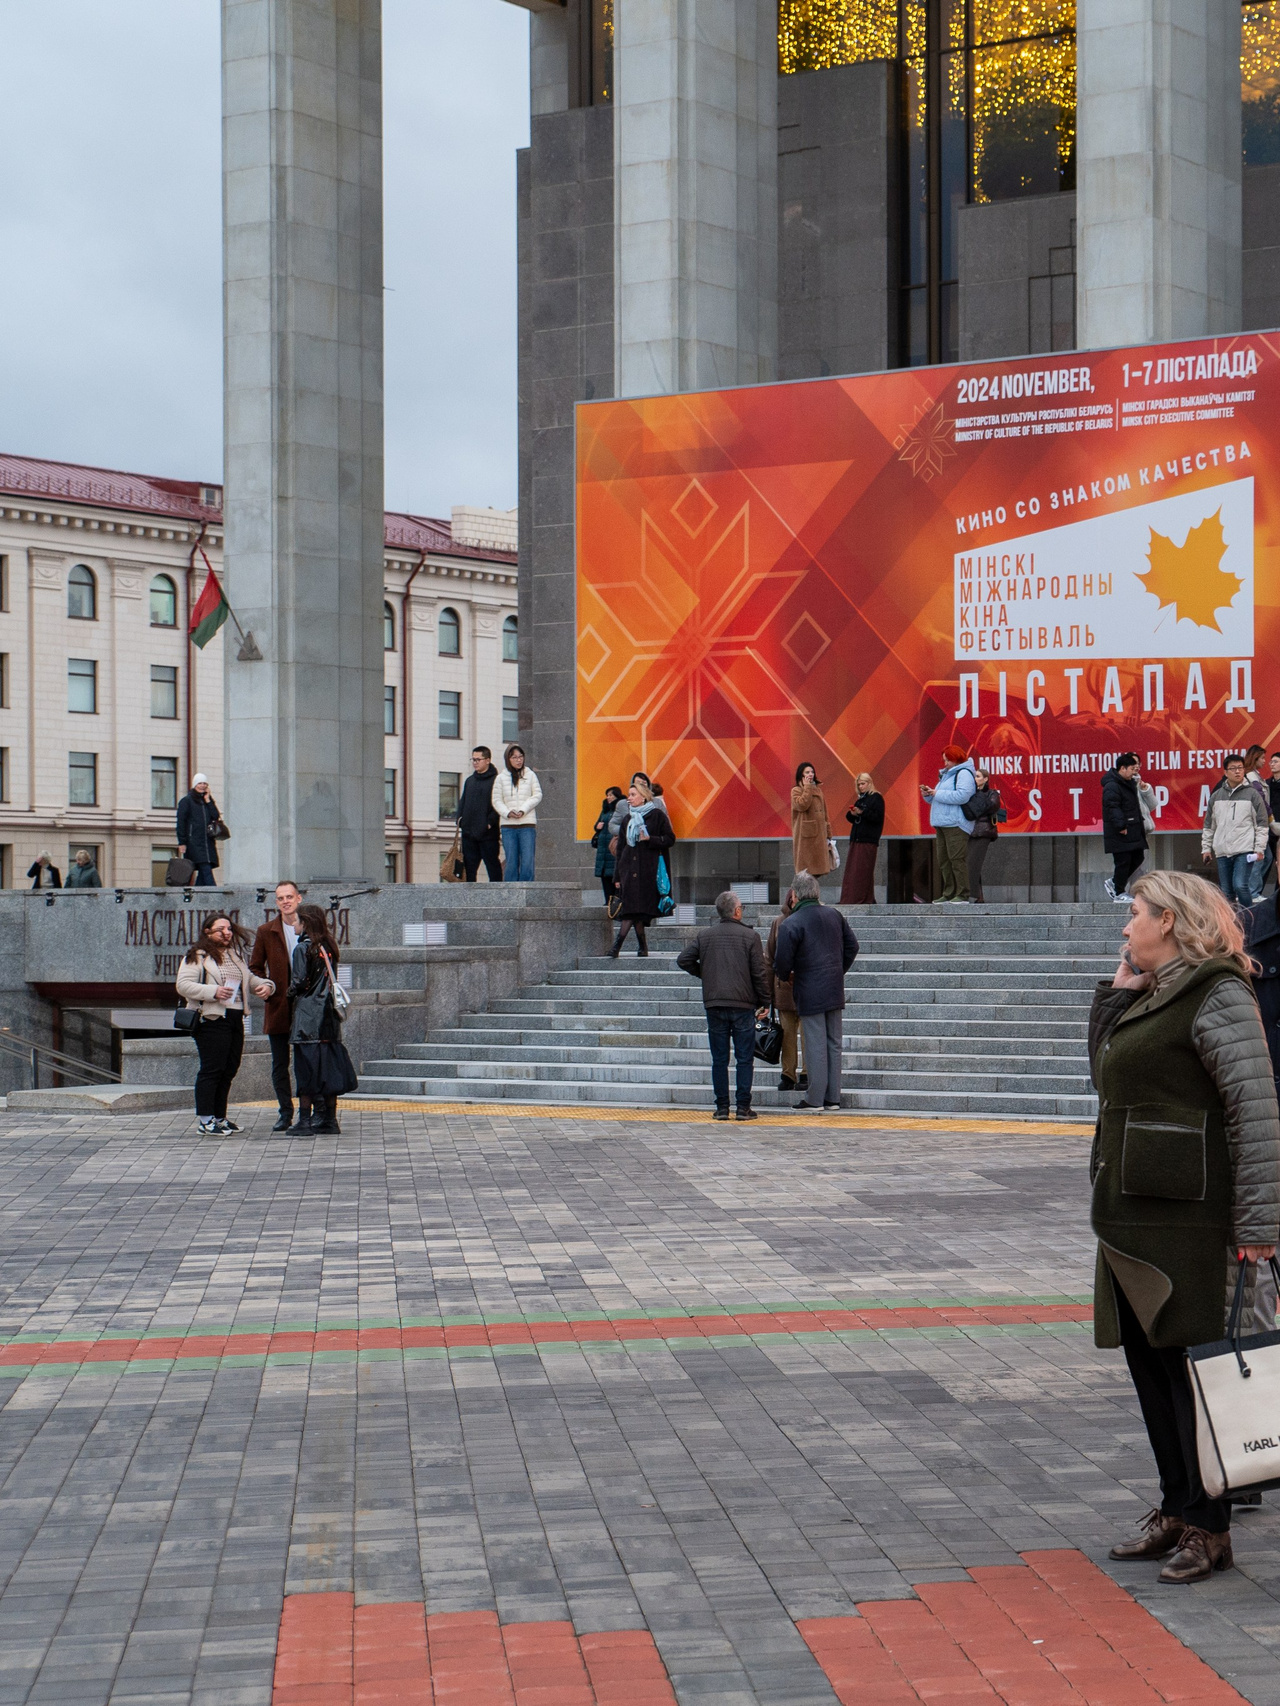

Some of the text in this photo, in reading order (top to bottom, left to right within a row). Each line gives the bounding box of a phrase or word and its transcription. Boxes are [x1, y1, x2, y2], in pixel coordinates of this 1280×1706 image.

[1154, 350, 1257, 384] ЛІСТАПАДА
[957, 367, 1095, 403] 2024 NOVEMBER,
[1146, 398, 1179, 411] ГАРАДСКІ
[1180, 393, 1224, 408] ВЫКАНАЎЧЫ
[1225, 390, 1256, 403] КАМІТЭТ
[1001, 411, 1037, 424] КУЛЬТУРЫ
[1078, 404, 1113, 417] БЕЛАРУСЬ
[1122, 407, 1235, 427] MINSK CITY EXECUTIVE COMMITTEE
[955, 418, 1113, 442] MINISTRY OF CULTURE OF THE REPUBLIC OF BELARUS
[956, 441, 1251, 535] КИНО СО ЗНАКОМ КАЧЕСТВА
[960, 553, 1034, 579] МІНСКІ
[960, 572, 1112, 604] МІЖНАРОДНЫ
[960, 604, 1008, 628] КІНА
[960, 624, 1095, 652] ФЕСТЫВАЛЬ
[955, 659, 1255, 719] ЛІСТАПАД
[979, 755, 1023, 775] MINSK
[1029, 752, 1122, 774] INTERNATION
[1147, 751, 1180, 770] FILM
[1243, 1438, 1280, 1453] KARL
